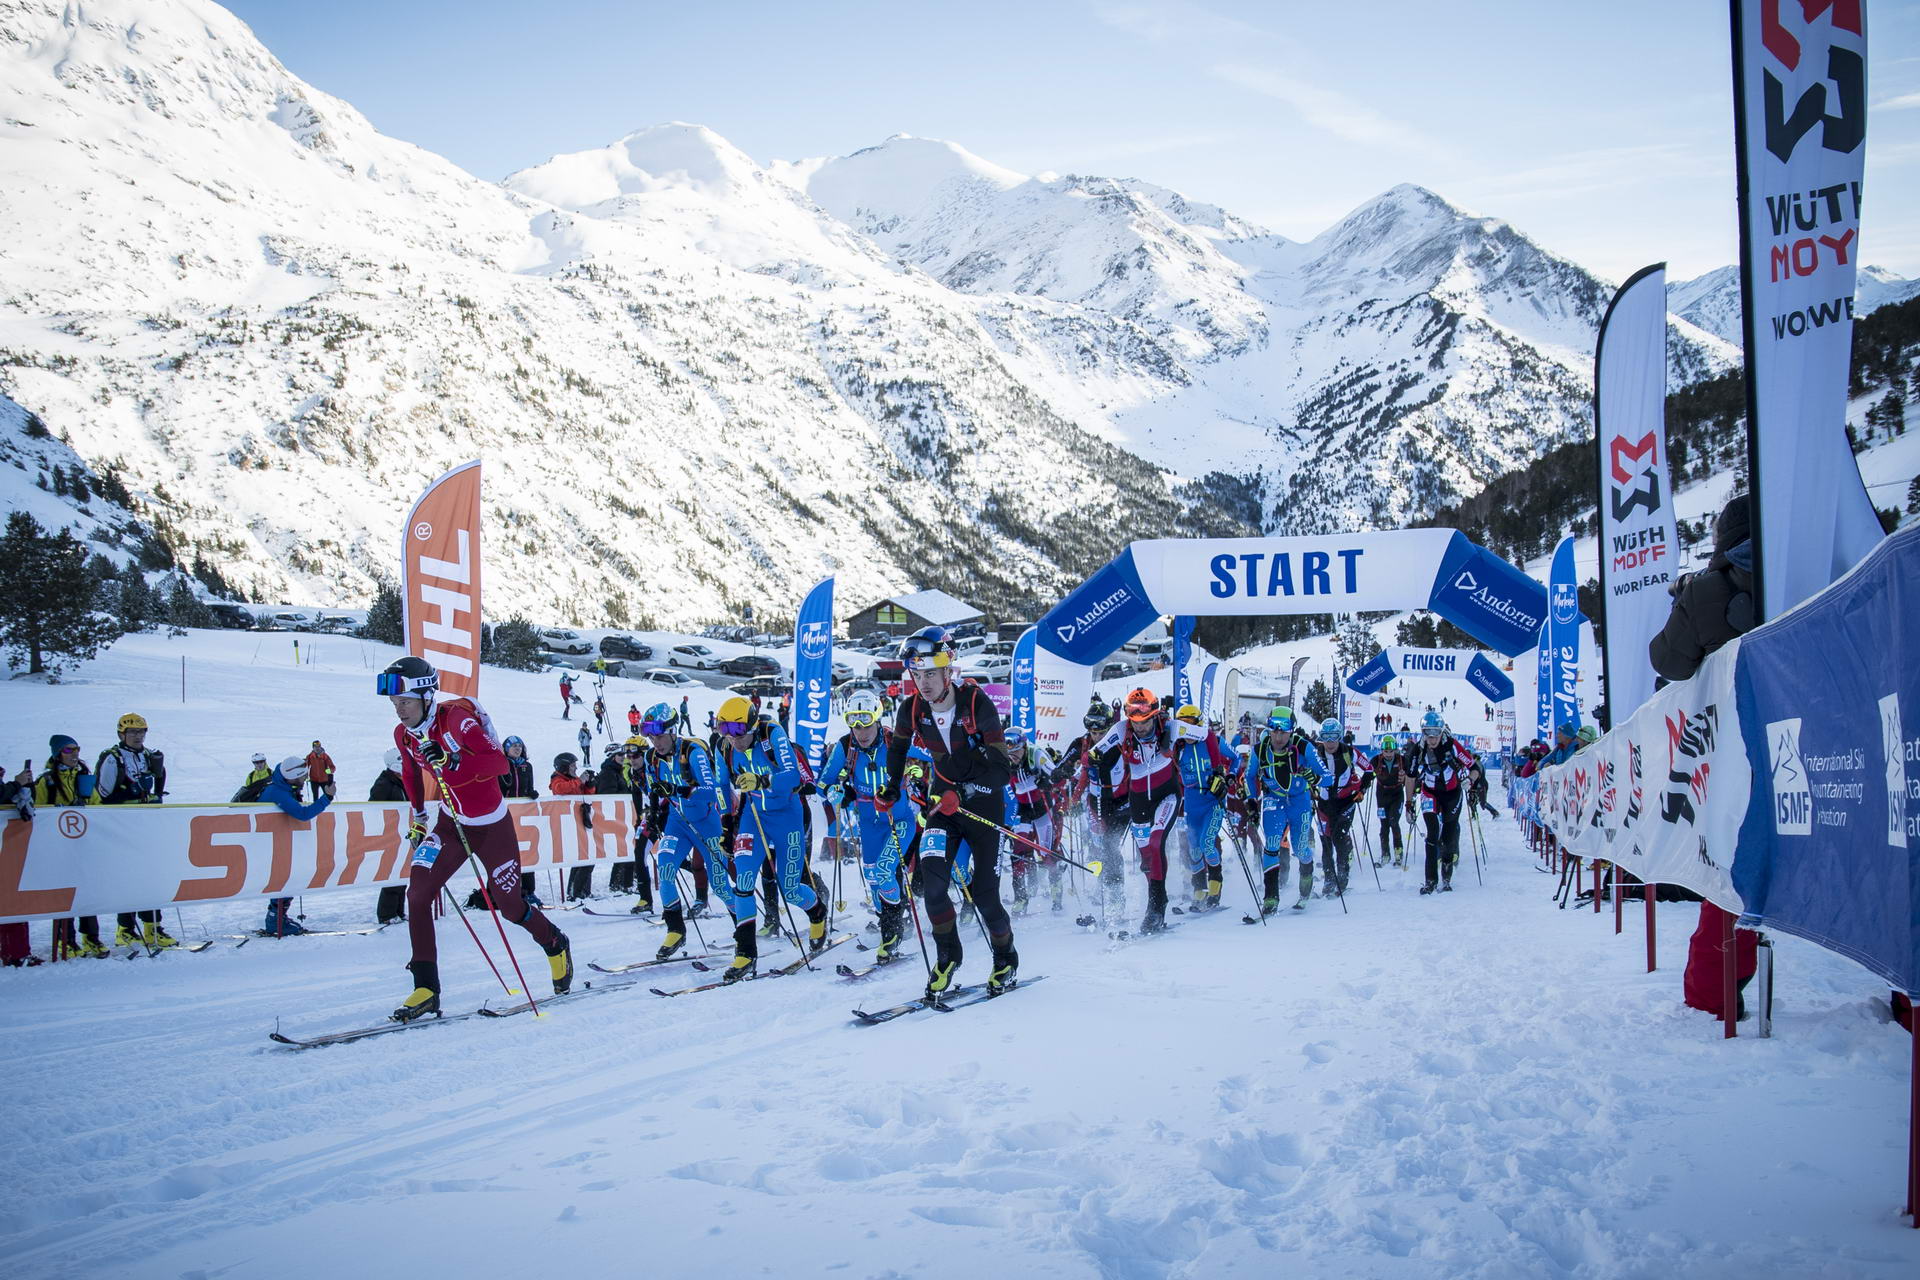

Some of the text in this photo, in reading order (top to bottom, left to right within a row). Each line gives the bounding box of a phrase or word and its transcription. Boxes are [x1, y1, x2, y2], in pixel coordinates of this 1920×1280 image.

[1210, 548, 1364, 598] START
[1074, 588, 1127, 631] Andorra
[1473, 586, 1537, 628] Andorra
[1403, 653, 1456, 672] FINISH
[1035, 706, 1066, 718] TIHL
[1855, 748, 1865, 770] Ski
[1777, 791, 1811, 825] ISMF
[739, 838, 745, 848] 1
[927, 837, 934, 847] 6
[419, 848, 427, 857] 3
